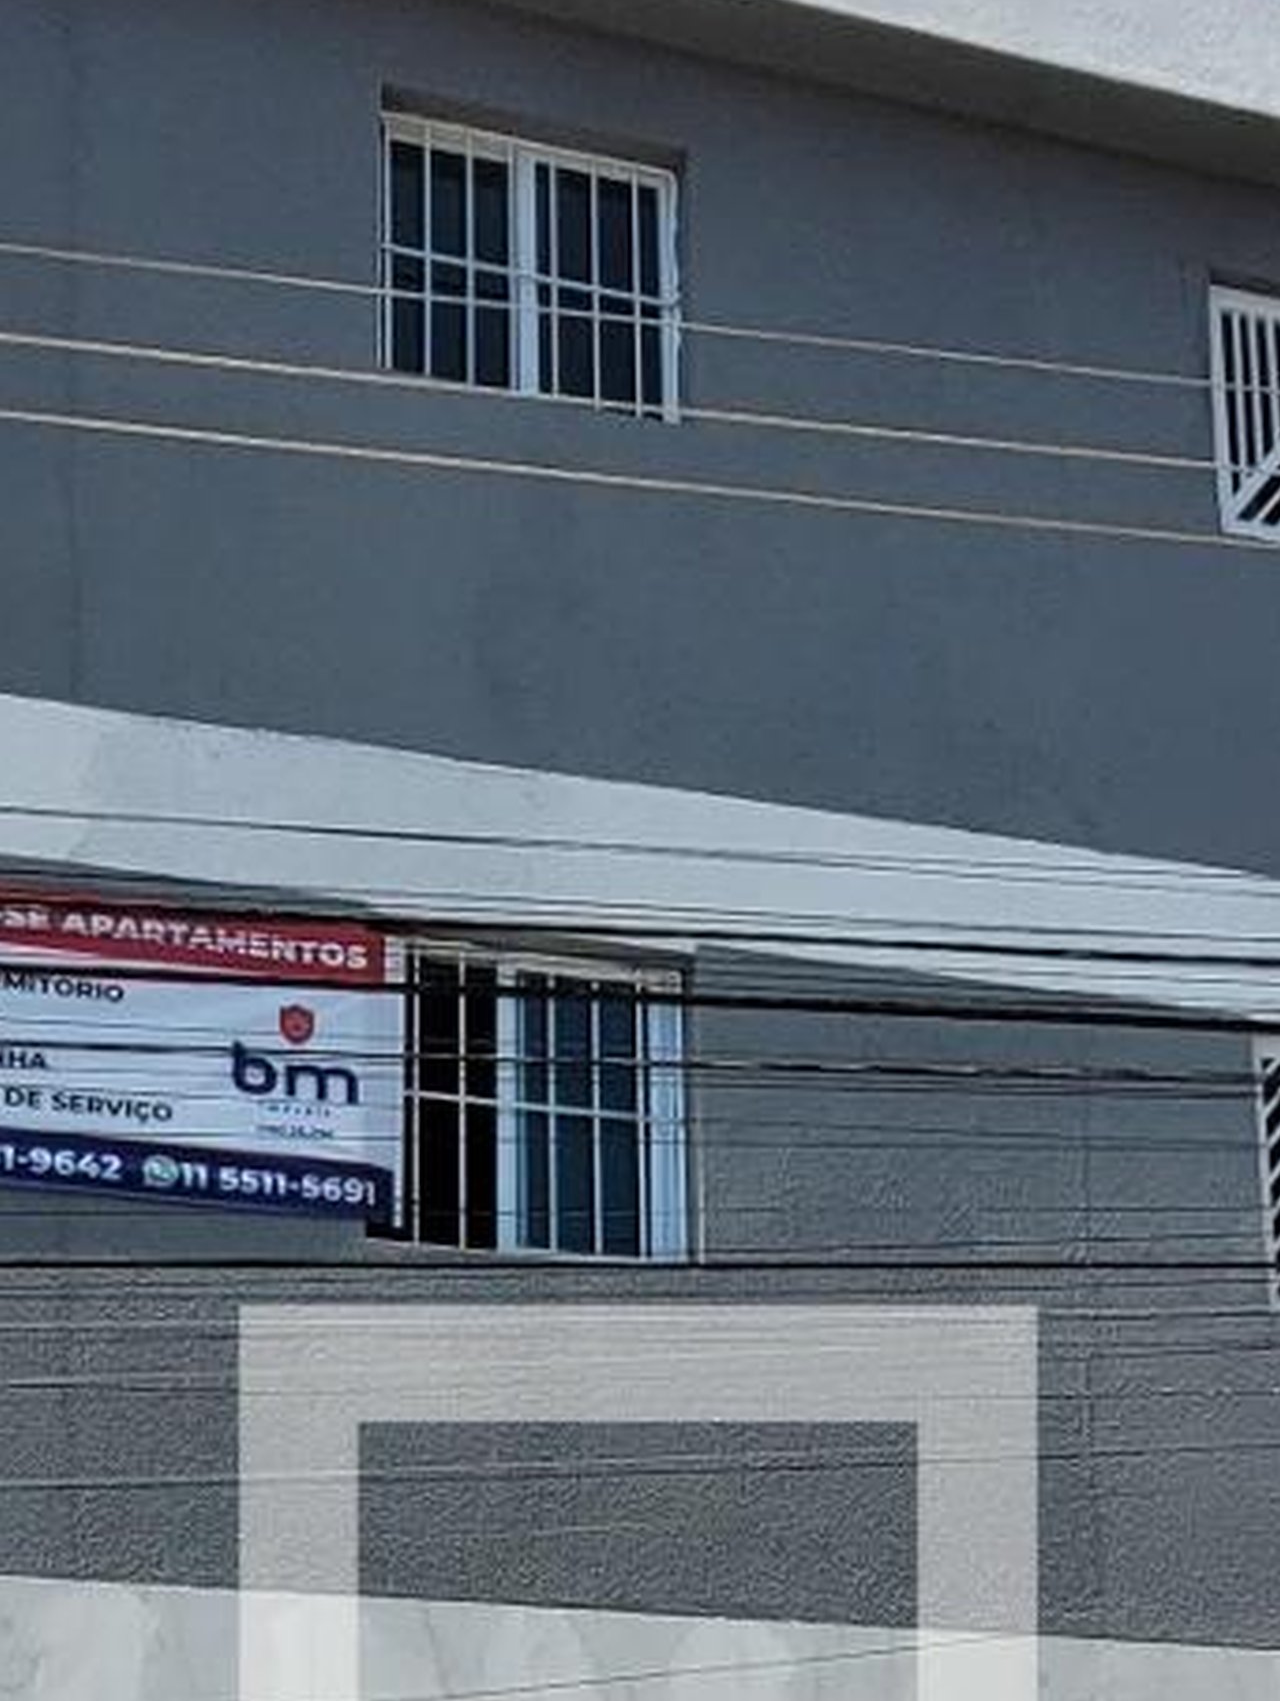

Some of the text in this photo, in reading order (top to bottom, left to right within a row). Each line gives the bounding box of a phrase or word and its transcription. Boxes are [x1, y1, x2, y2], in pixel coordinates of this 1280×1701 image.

[61, 911, 368, 969] APARTAMENTOS
[232, 1039, 359, 1105] bm
[3, 1084, 43, 1110] DE
[50, 1091, 173, 1124] SERVIÇO
[181, 1161, 208, 1189] 11
[219, 1165, 376, 1206] 5511-5691
